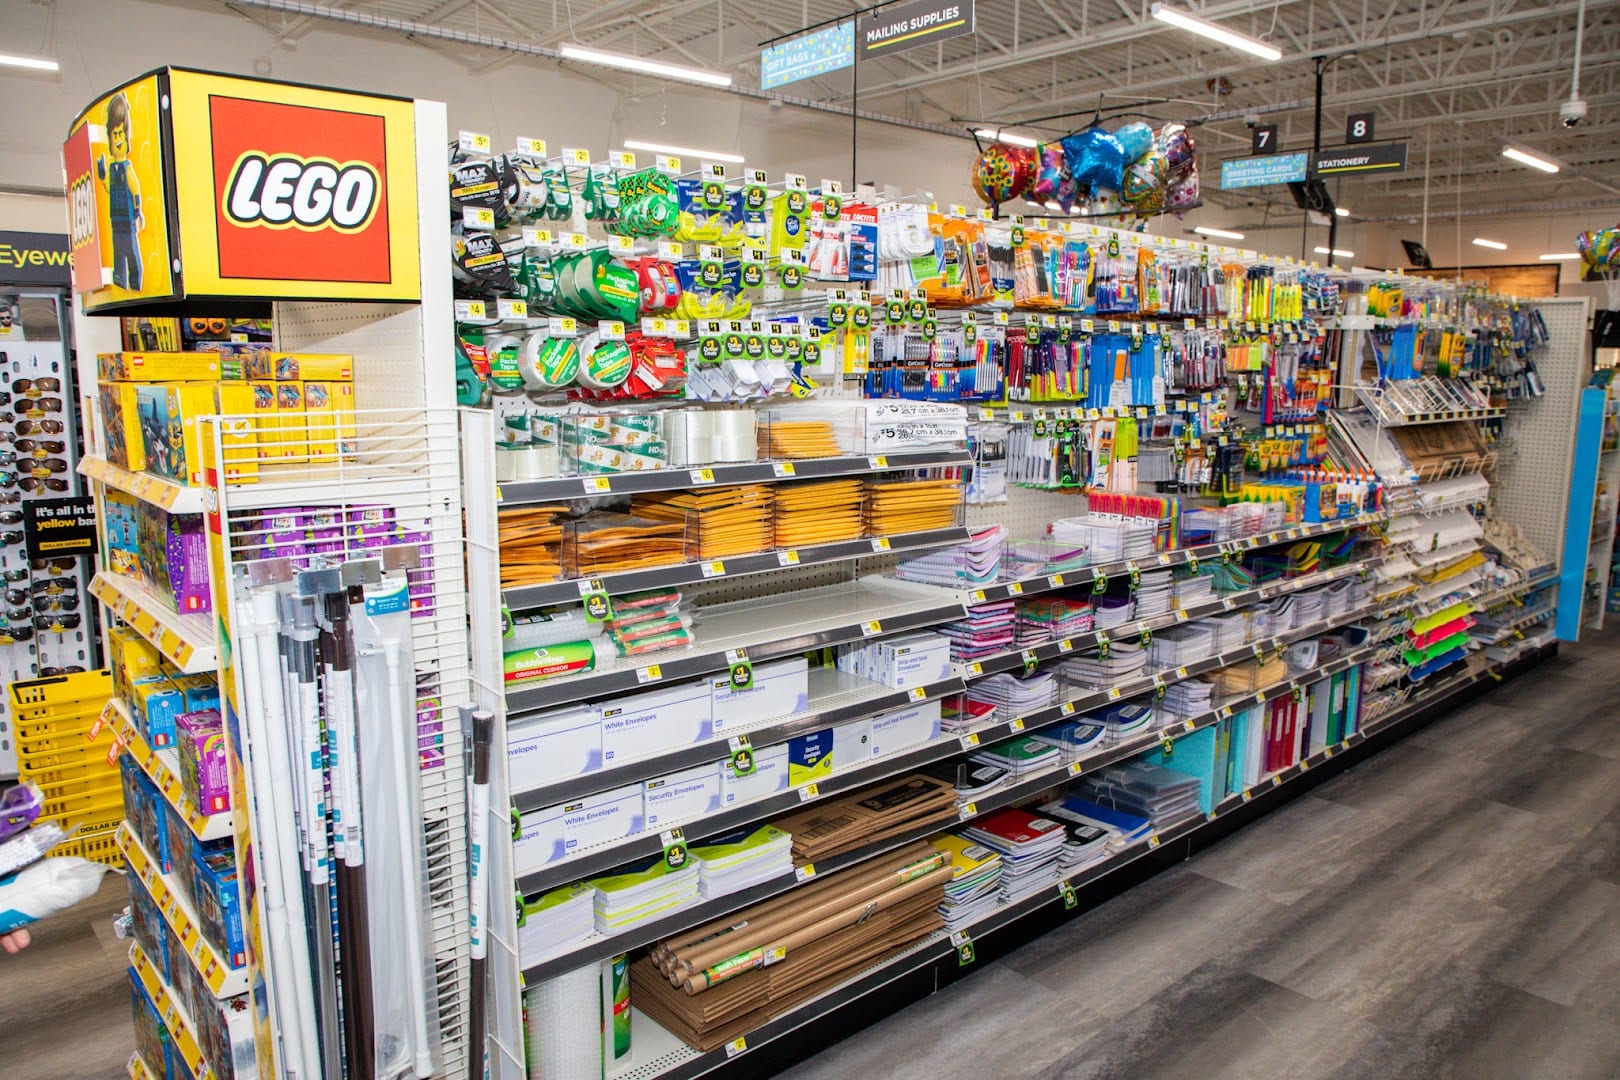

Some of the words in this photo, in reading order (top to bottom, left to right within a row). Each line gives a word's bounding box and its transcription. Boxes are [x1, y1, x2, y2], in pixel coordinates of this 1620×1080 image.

[866, 20, 908, 42] MAILING
[910, 6, 960, 30] SUPPLIES
[766, 56, 784, 72] GIFT
[786, 50, 808, 65] BAGS
[1352, 120, 1366, 137] 8
[1258, 131, 1270, 148] 7
[1266, 164, 1293, 175] CARDS
[1318, 156, 1370, 169] STATIONERY
[455, 168, 488, 182] MAX
[229, 156, 377, 229] LEGO
[71, 179, 94, 242] LEGO
[853, 213, 876, 222] LOCTITE
[466, 238, 494, 252] MAX
[35, 507, 54, 517] it's
[56, 506, 71, 516] all
[73, 505, 85, 515] in
[36, 518, 76, 531] yellow
[515, 668, 542, 679] ORIGINAL
[543, 664, 568, 674] CUSHION
[715, 690, 737, 700] Security
[604, 721, 624, 730] White
[625, 714, 657, 726] Envelopes
[649, 791, 673, 801] Security
[674, 783, 705, 796] Envelopes
[565, 816, 585, 825] White
[586, 806, 619, 820] Envelopes
[80, 823, 110, 833] DOLLAR
